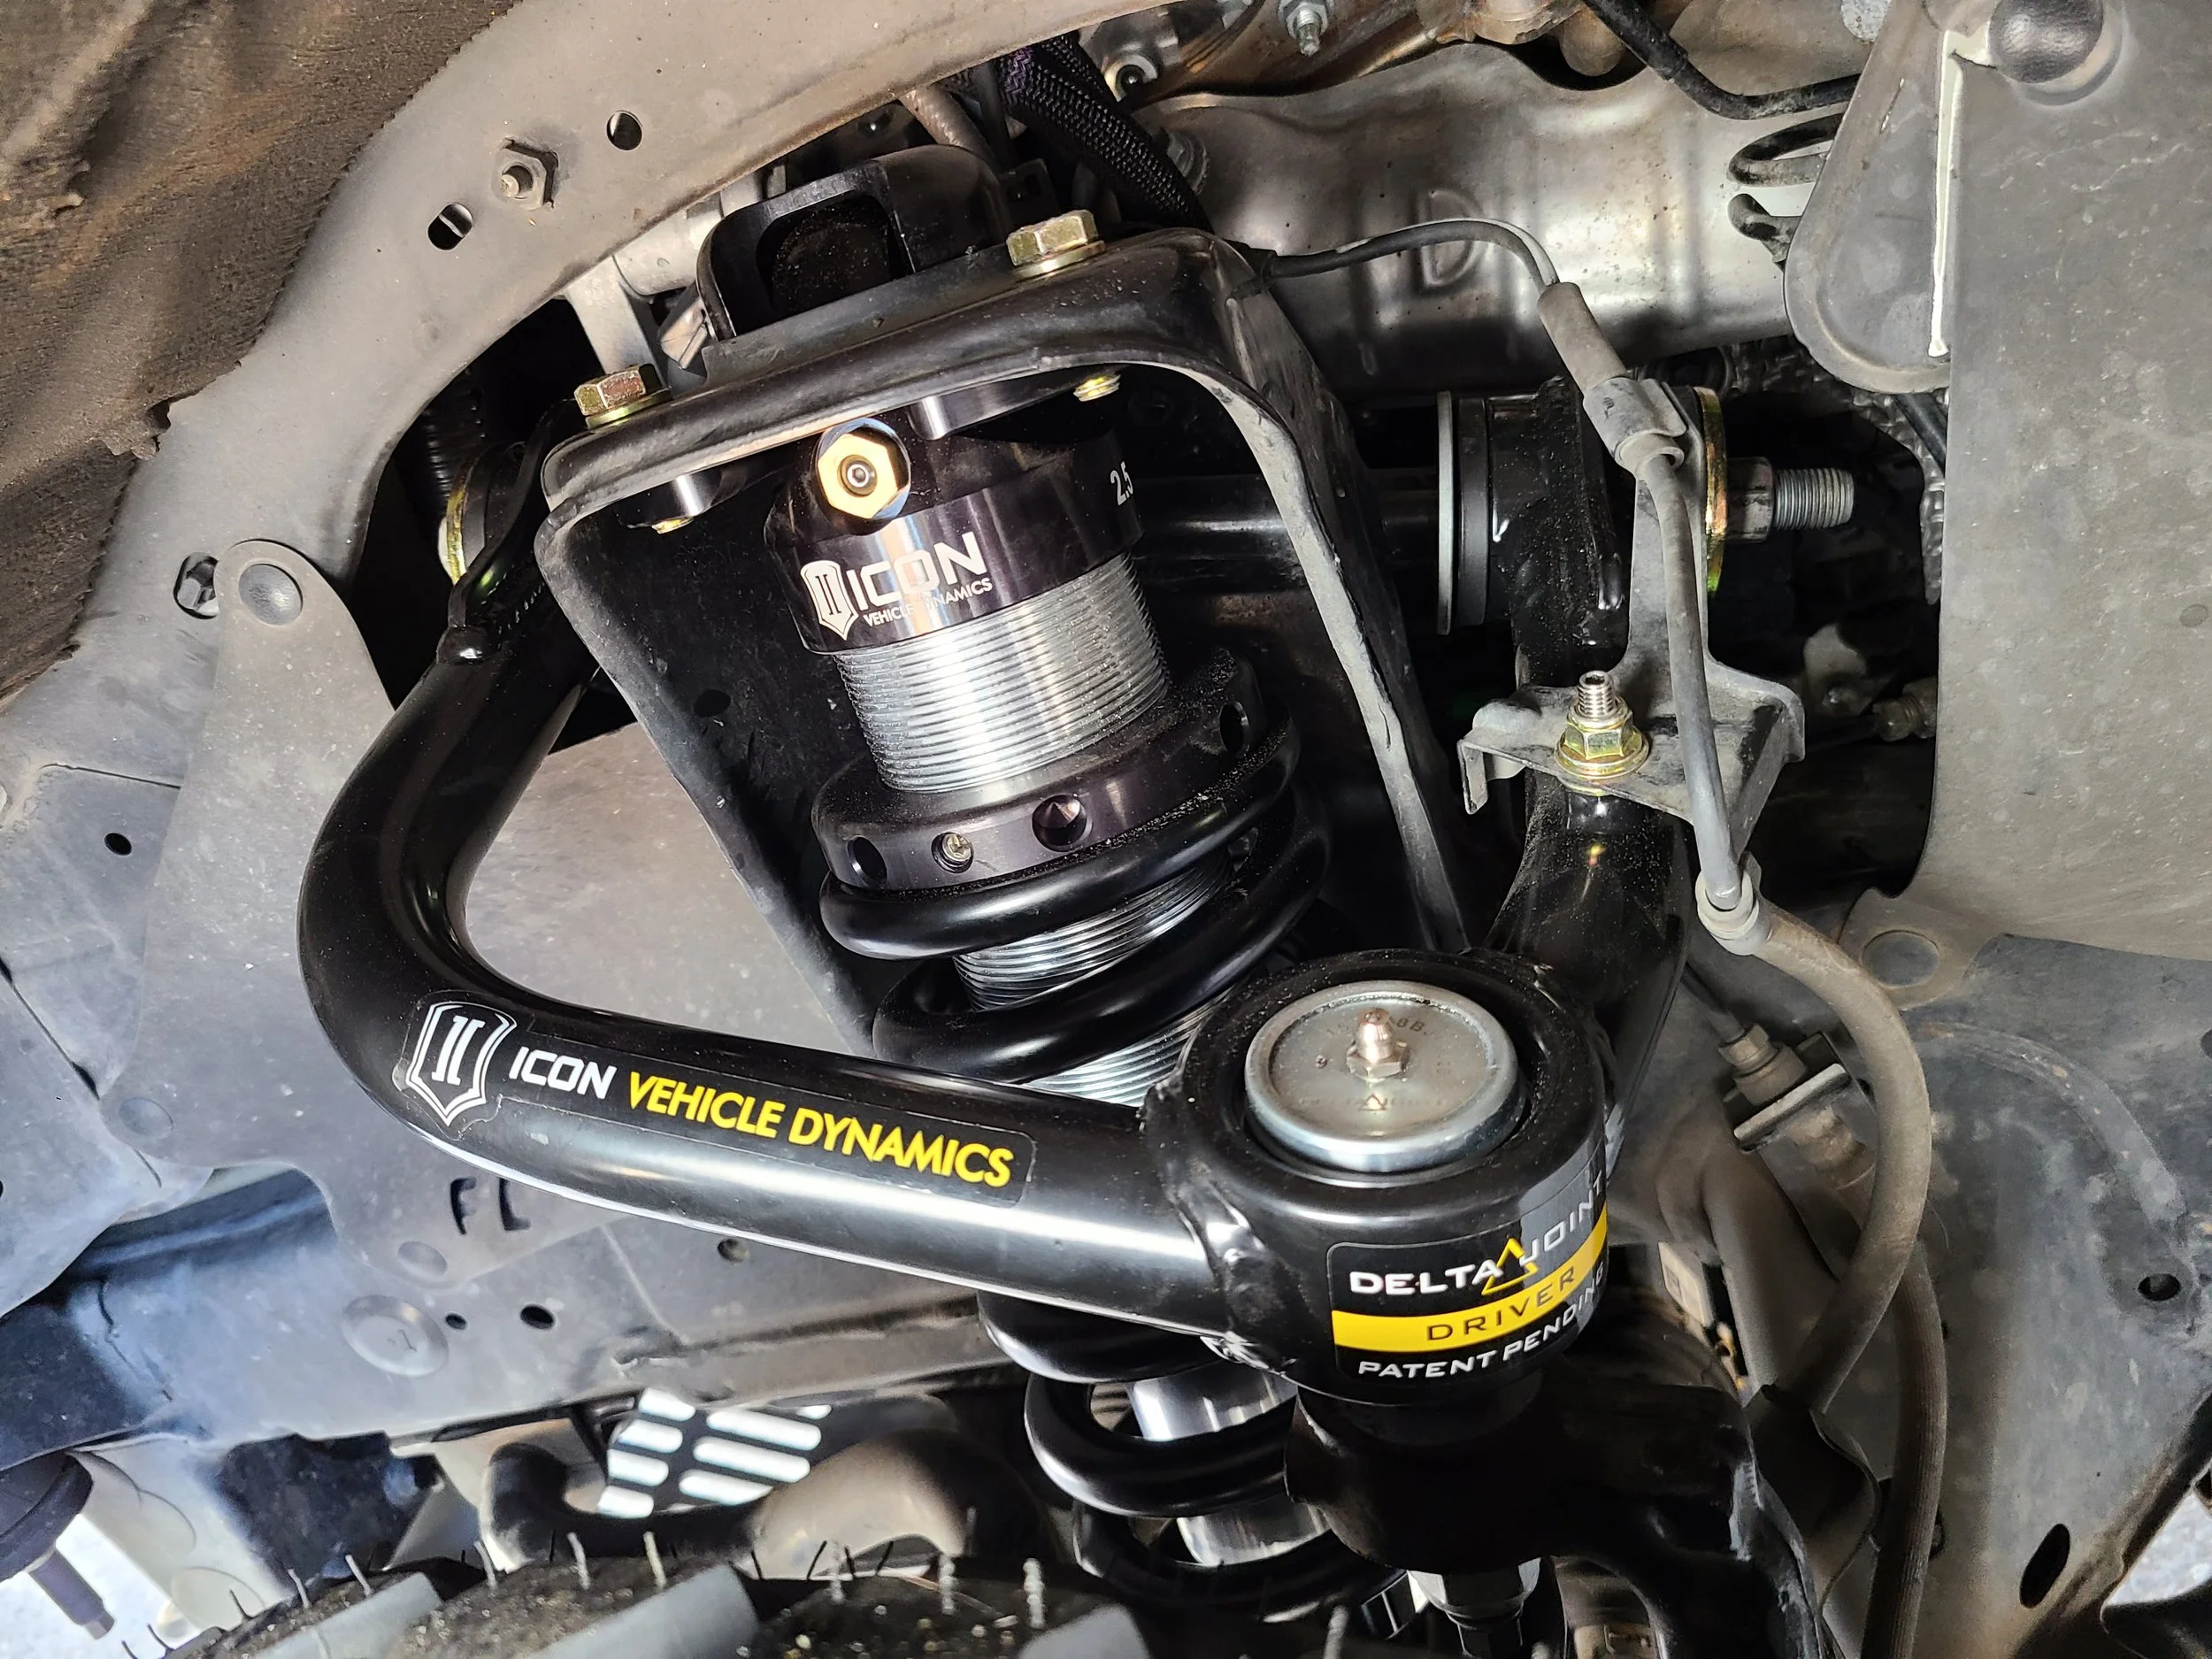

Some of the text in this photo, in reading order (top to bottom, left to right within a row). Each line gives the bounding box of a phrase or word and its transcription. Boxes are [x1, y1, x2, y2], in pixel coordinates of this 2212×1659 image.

[1110, 460, 1133, 506] 2.5
[847, 531, 987, 611] ICON
[864, 577, 993, 626] VEHICLE YNAMICS
[509, 1046, 1015, 1188] ICON VEHICLE DYNAMICS
[1349, 1169, 1602, 1296] DELTA JOINT
[1426, 1265, 1575, 1341] DRIVER
[1357, 1349, 1498, 1379] PATENT
